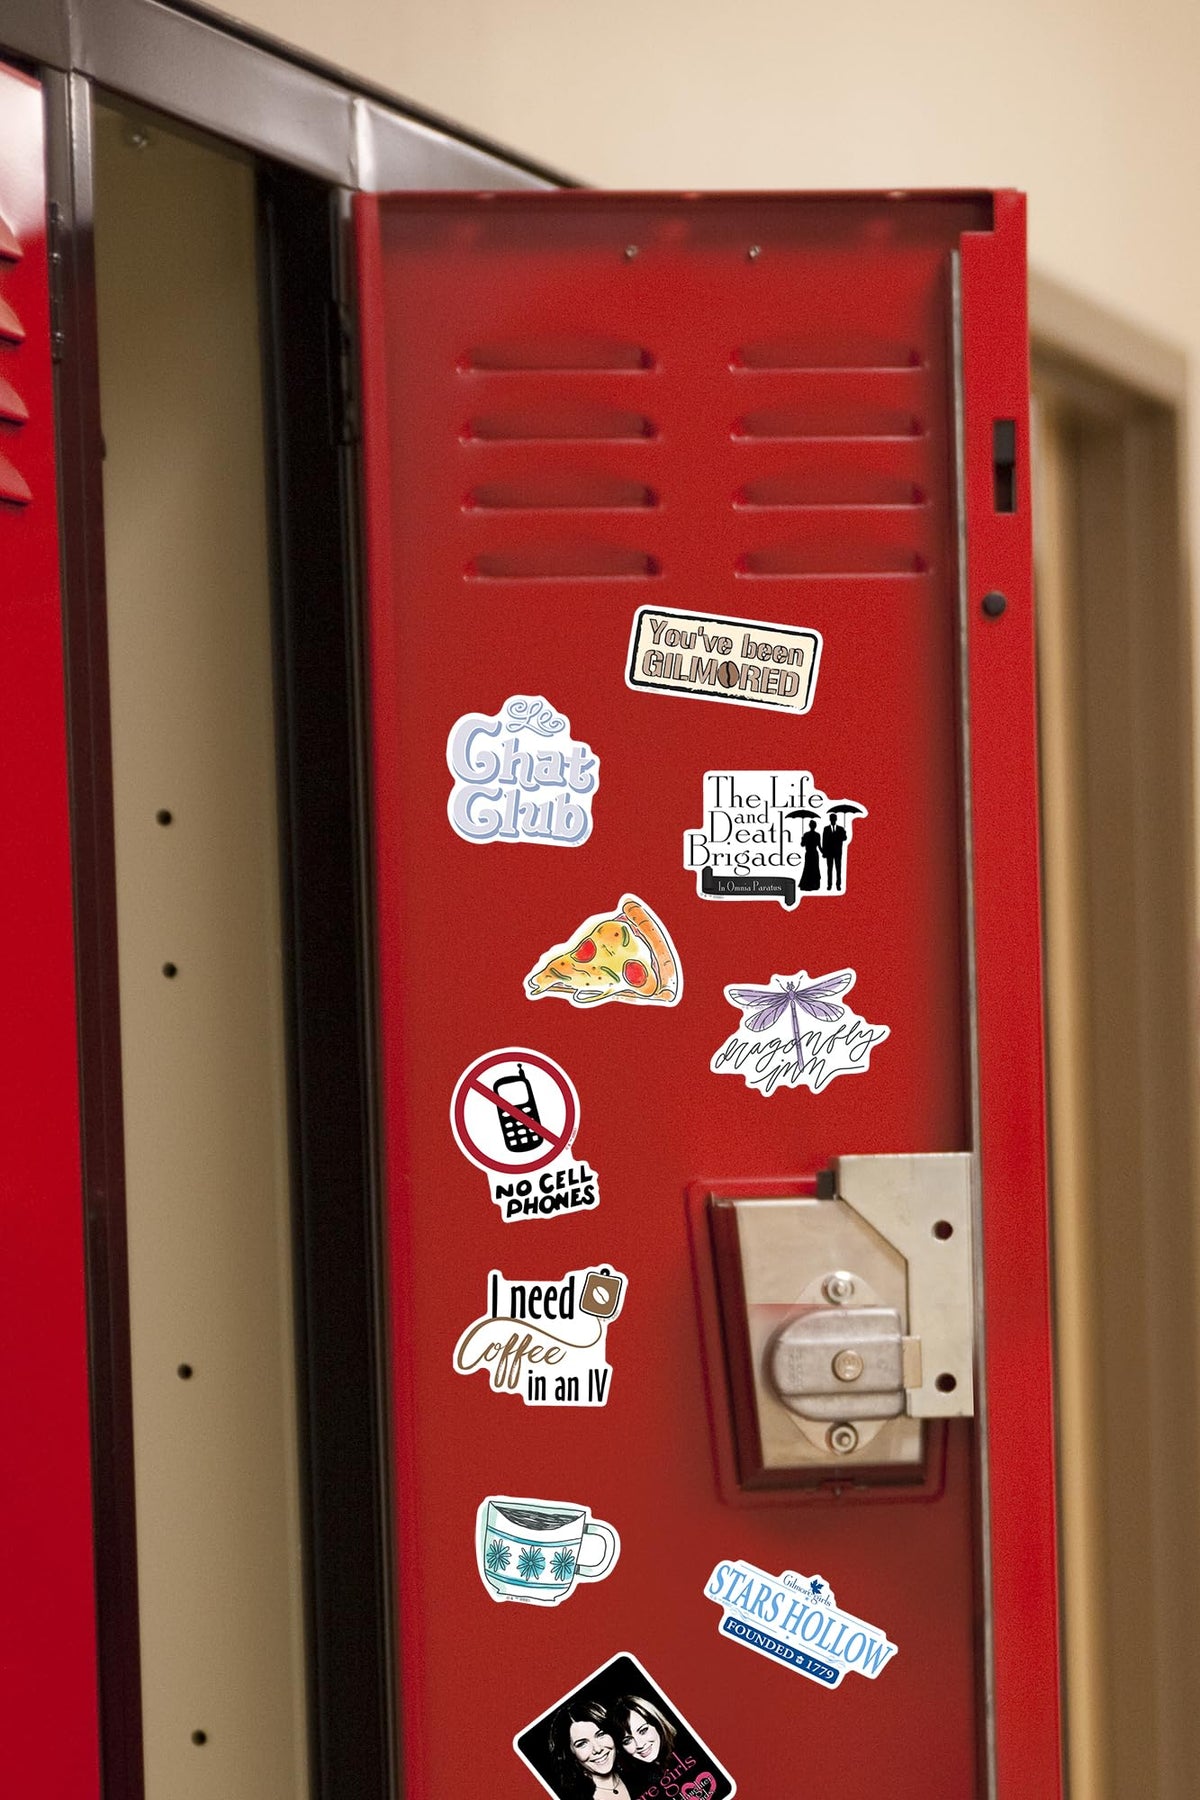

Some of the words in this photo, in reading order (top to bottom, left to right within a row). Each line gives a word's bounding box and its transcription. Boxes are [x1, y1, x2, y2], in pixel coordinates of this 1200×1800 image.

[649, 618, 733, 655] You've
[740, 632, 805, 667] been
[506, 699, 566, 738] Le
[452, 718, 596, 794] Chat
[708, 775, 762, 808] The
[770, 775, 824, 808] Life
[453, 785, 589, 843] Club
[708, 810, 793, 844] Death
[734, 800, 770, 825] and
[687, 833, 802, 877] Brigade
[718, 881, 726, 892] In
[496, 1179, 533, 1199] NO
[539, 1165, 593, 1194] CELL
[506, 1184, 596, 1218] PHONES
[492, 1274, 498, 1318] I
[510, 1275, 575, 1320] need
[528, 1369, 546, 1401] in
[555, 1376, 579, 1402] an
[588, 1368, 608, 1402] IV
[708, 1564, 785, 1622] STARS
[779, 1598, 894, 1675] HOLLOW
[726, 1619, 795, 1660] FOUNDED
[806, 1660, 835, 1680] 1779
[660, 1751, 697, 1798] girls
